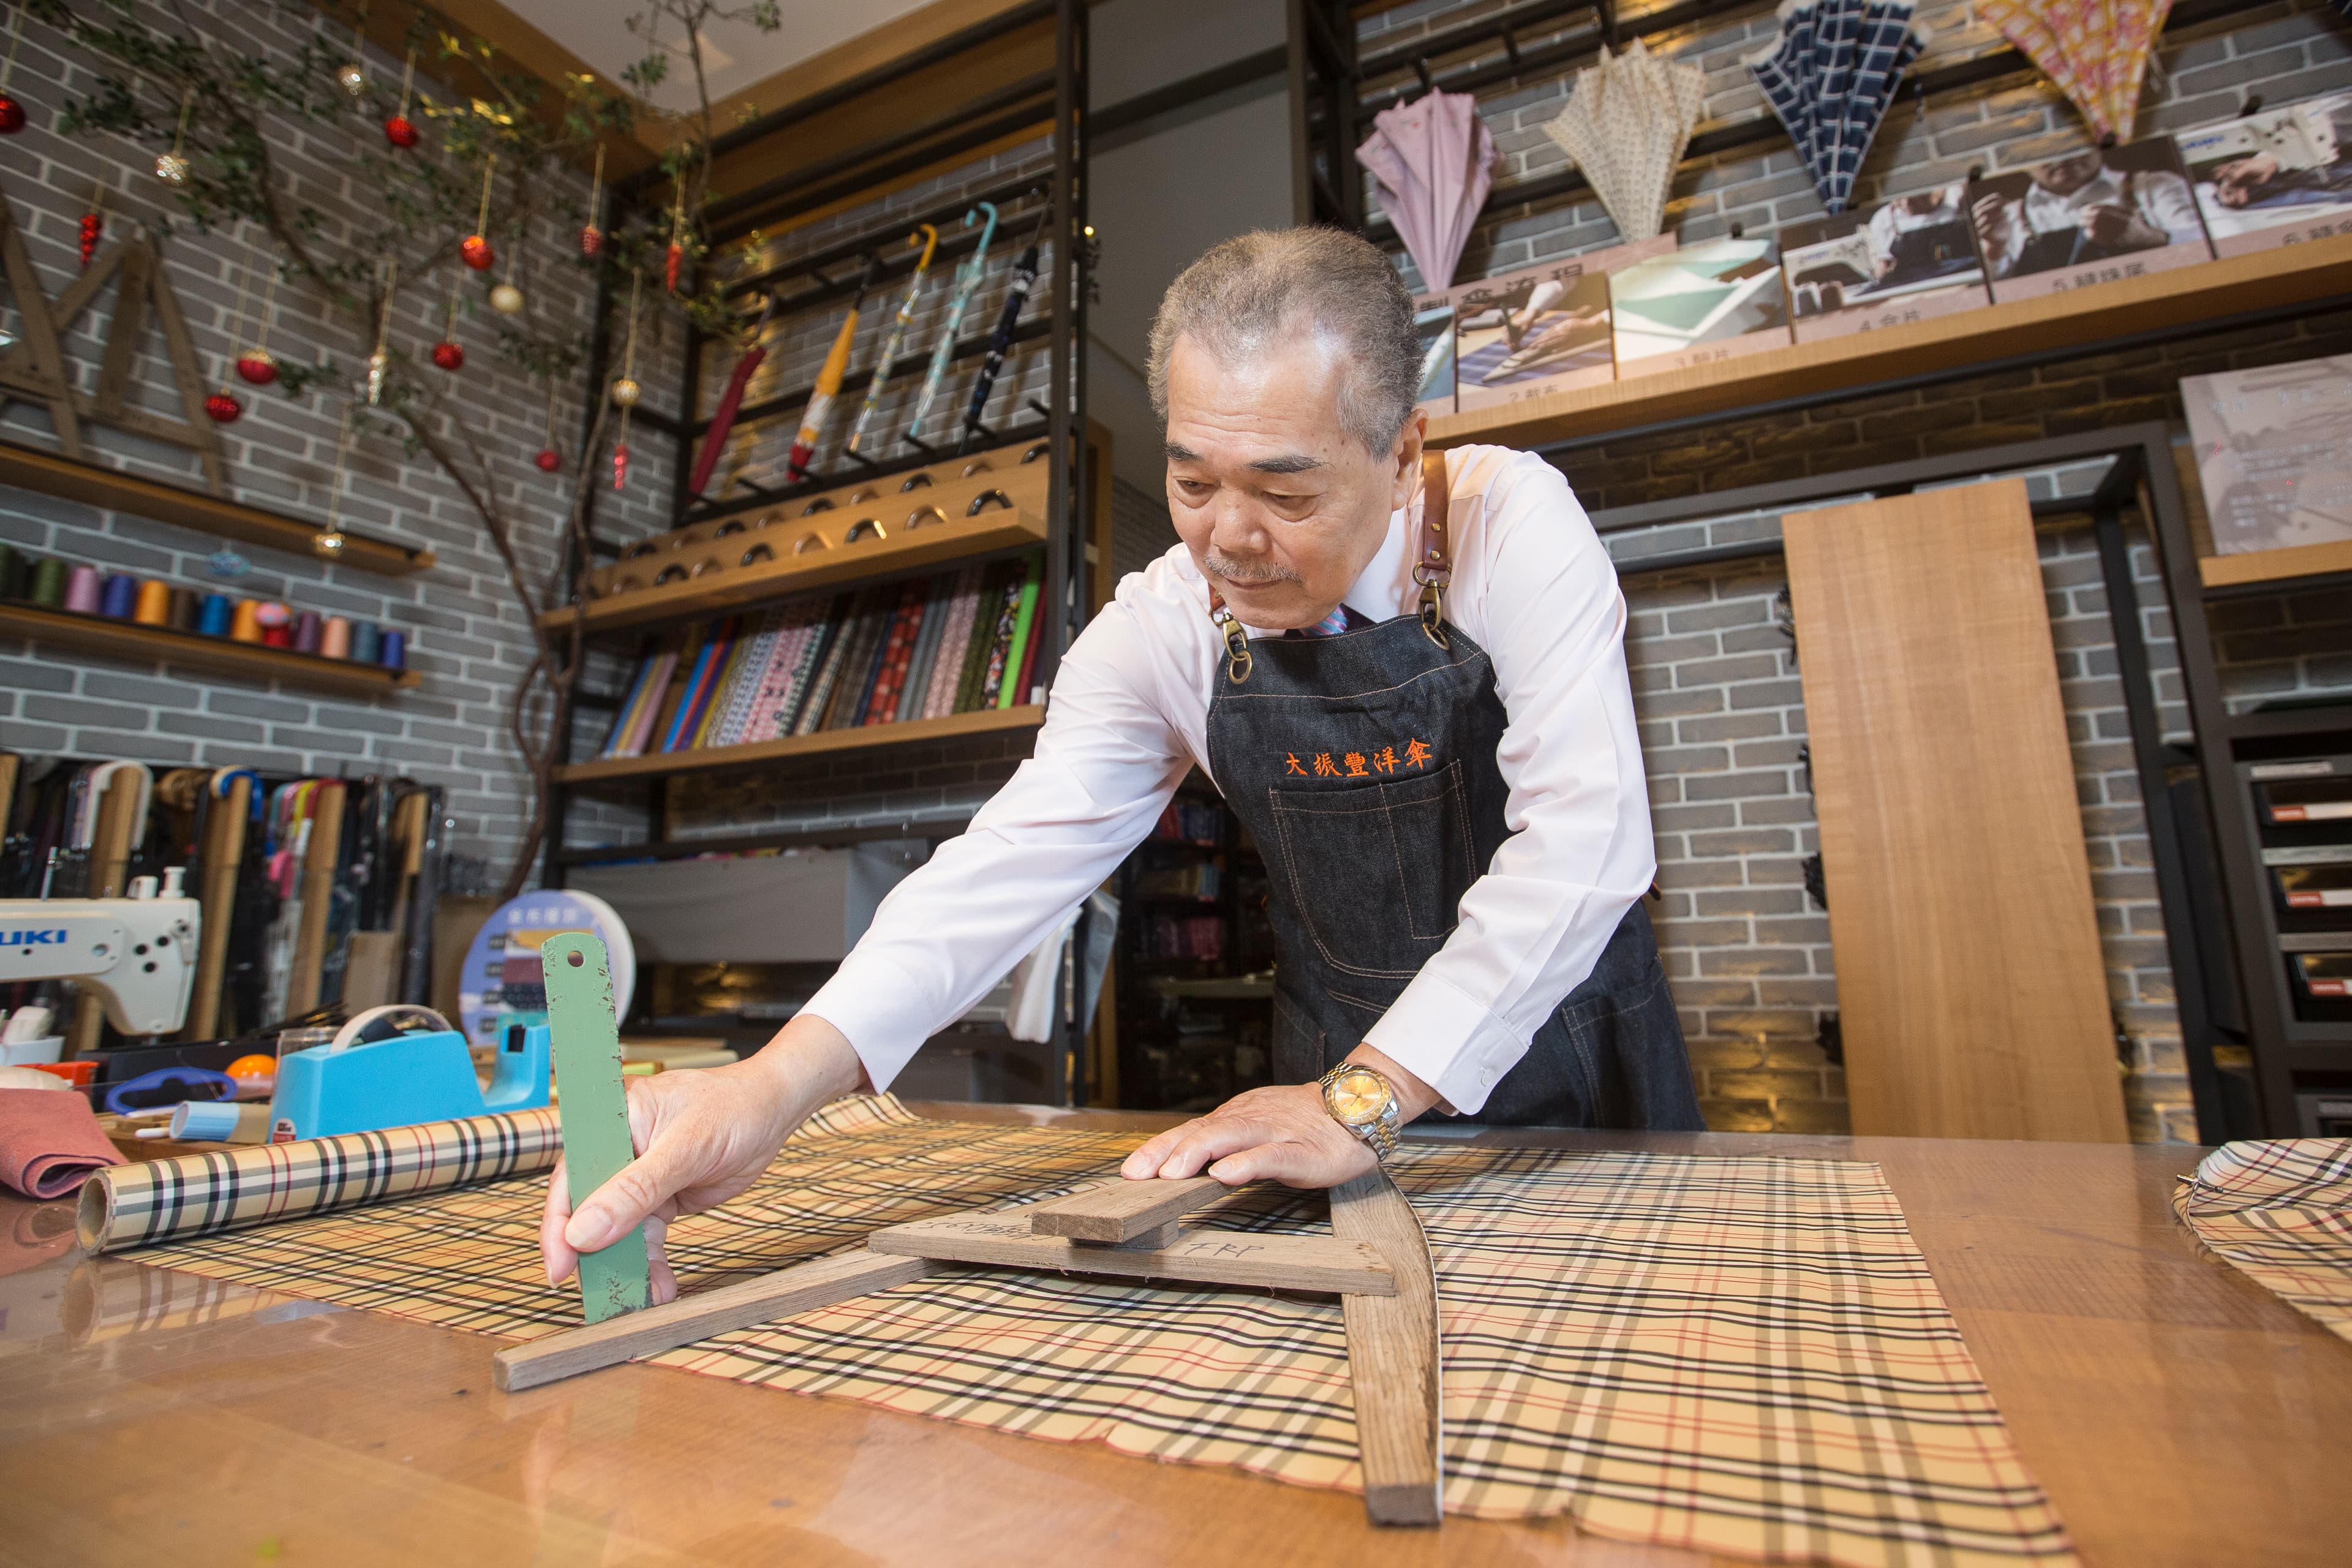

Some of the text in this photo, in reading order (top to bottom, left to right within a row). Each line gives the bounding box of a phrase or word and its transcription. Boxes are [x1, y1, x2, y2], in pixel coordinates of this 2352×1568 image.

[1286, 737, 1433, 777] 大振豐洋傘
